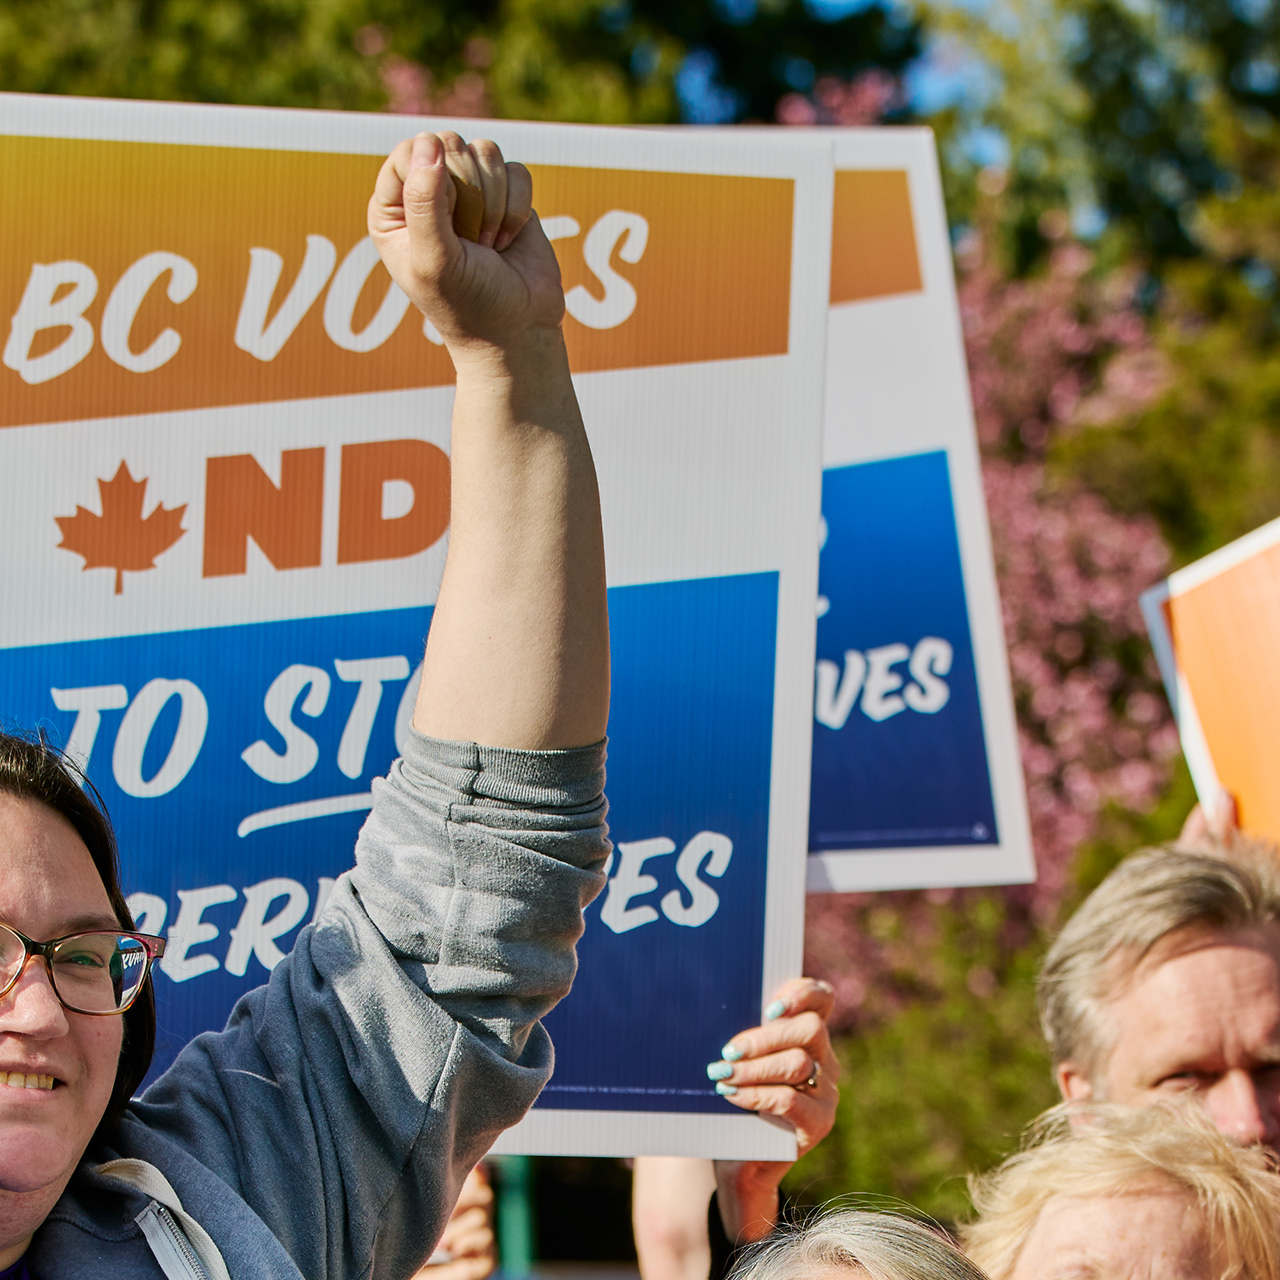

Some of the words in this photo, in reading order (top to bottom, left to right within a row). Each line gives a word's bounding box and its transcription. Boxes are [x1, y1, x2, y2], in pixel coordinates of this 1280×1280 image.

[3, 251, 198, 385] BC
[234, 209, 650, 363] VOS
[202, 438, 452, 578] ND
[51, 677, 209, 799] TO
